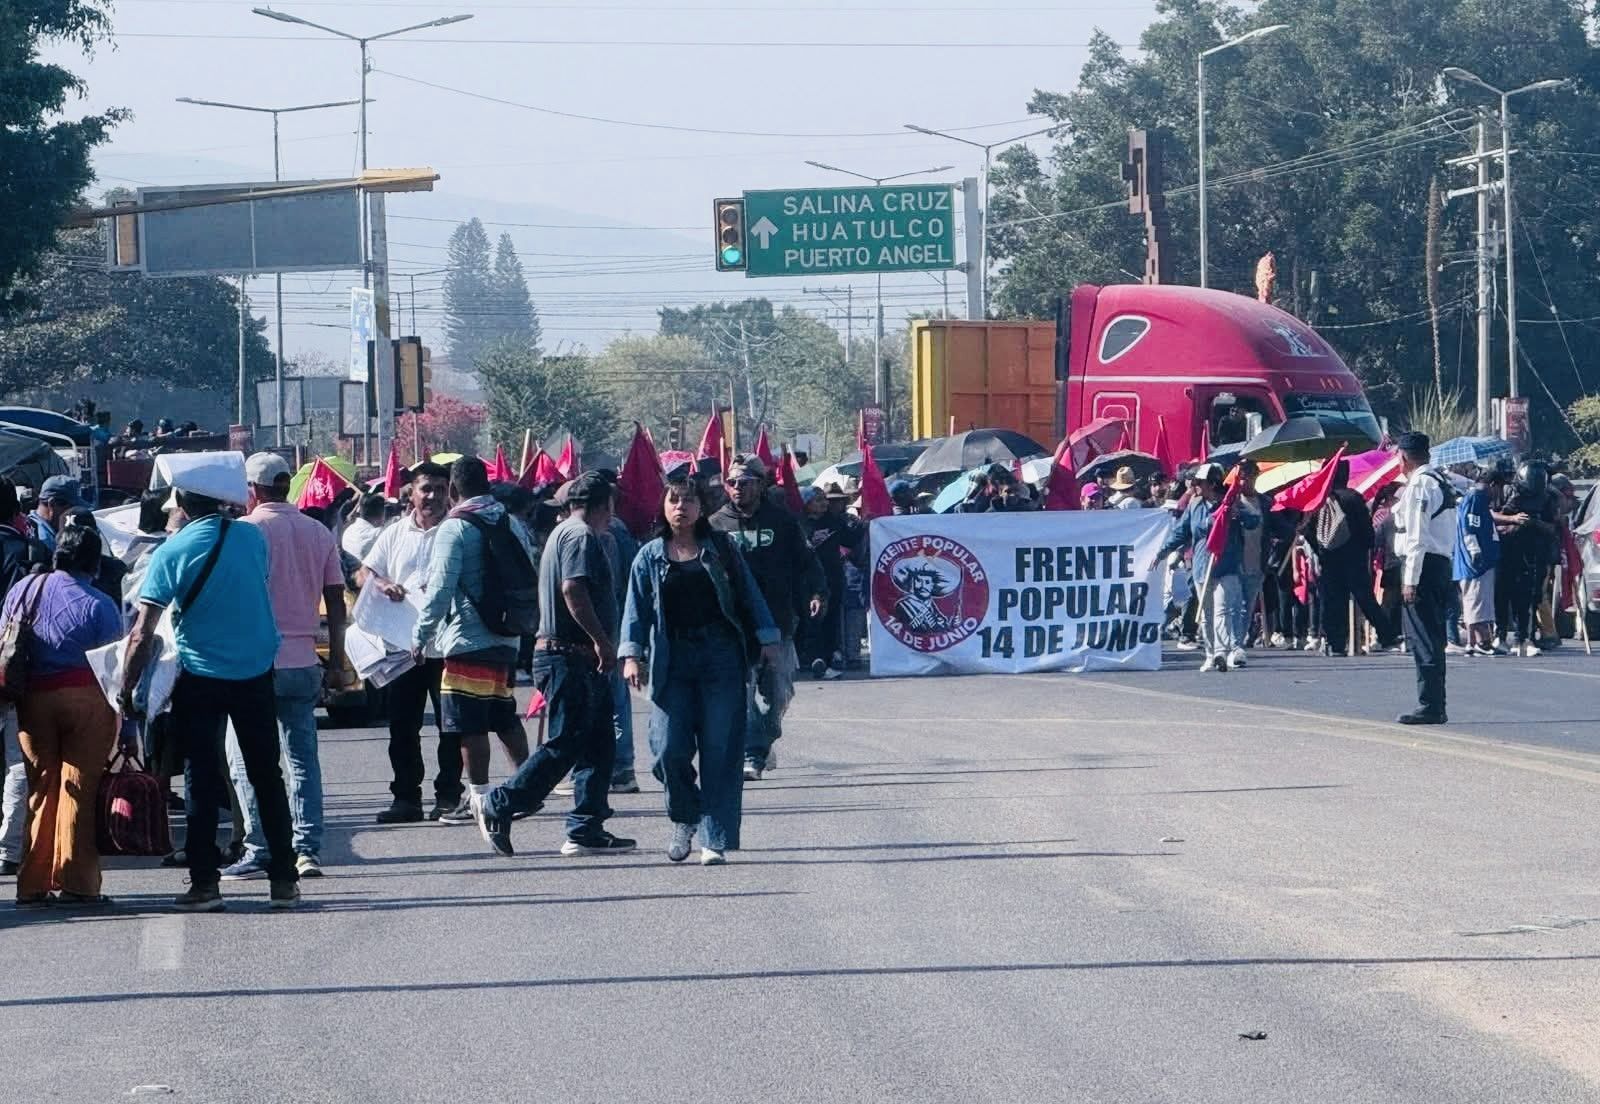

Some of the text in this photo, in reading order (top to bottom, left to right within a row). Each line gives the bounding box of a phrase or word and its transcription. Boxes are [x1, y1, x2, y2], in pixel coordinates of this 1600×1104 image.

[784, 191, 949, 216] SALINA CRUZ
[793, 218, 944, 242] HUATULCO
[785, 244, 951, 269] PUERTO ANGEL
[922, 537, 985, 583] POPULAR
[1015, 545, 1135, 582] FRENTE
[998, 582, 1149, 621] POPULAR
[885, 615, 978, 650] 14 DE JUNIO
[977, 619, 1161, 659] 14 DE JUNIO
